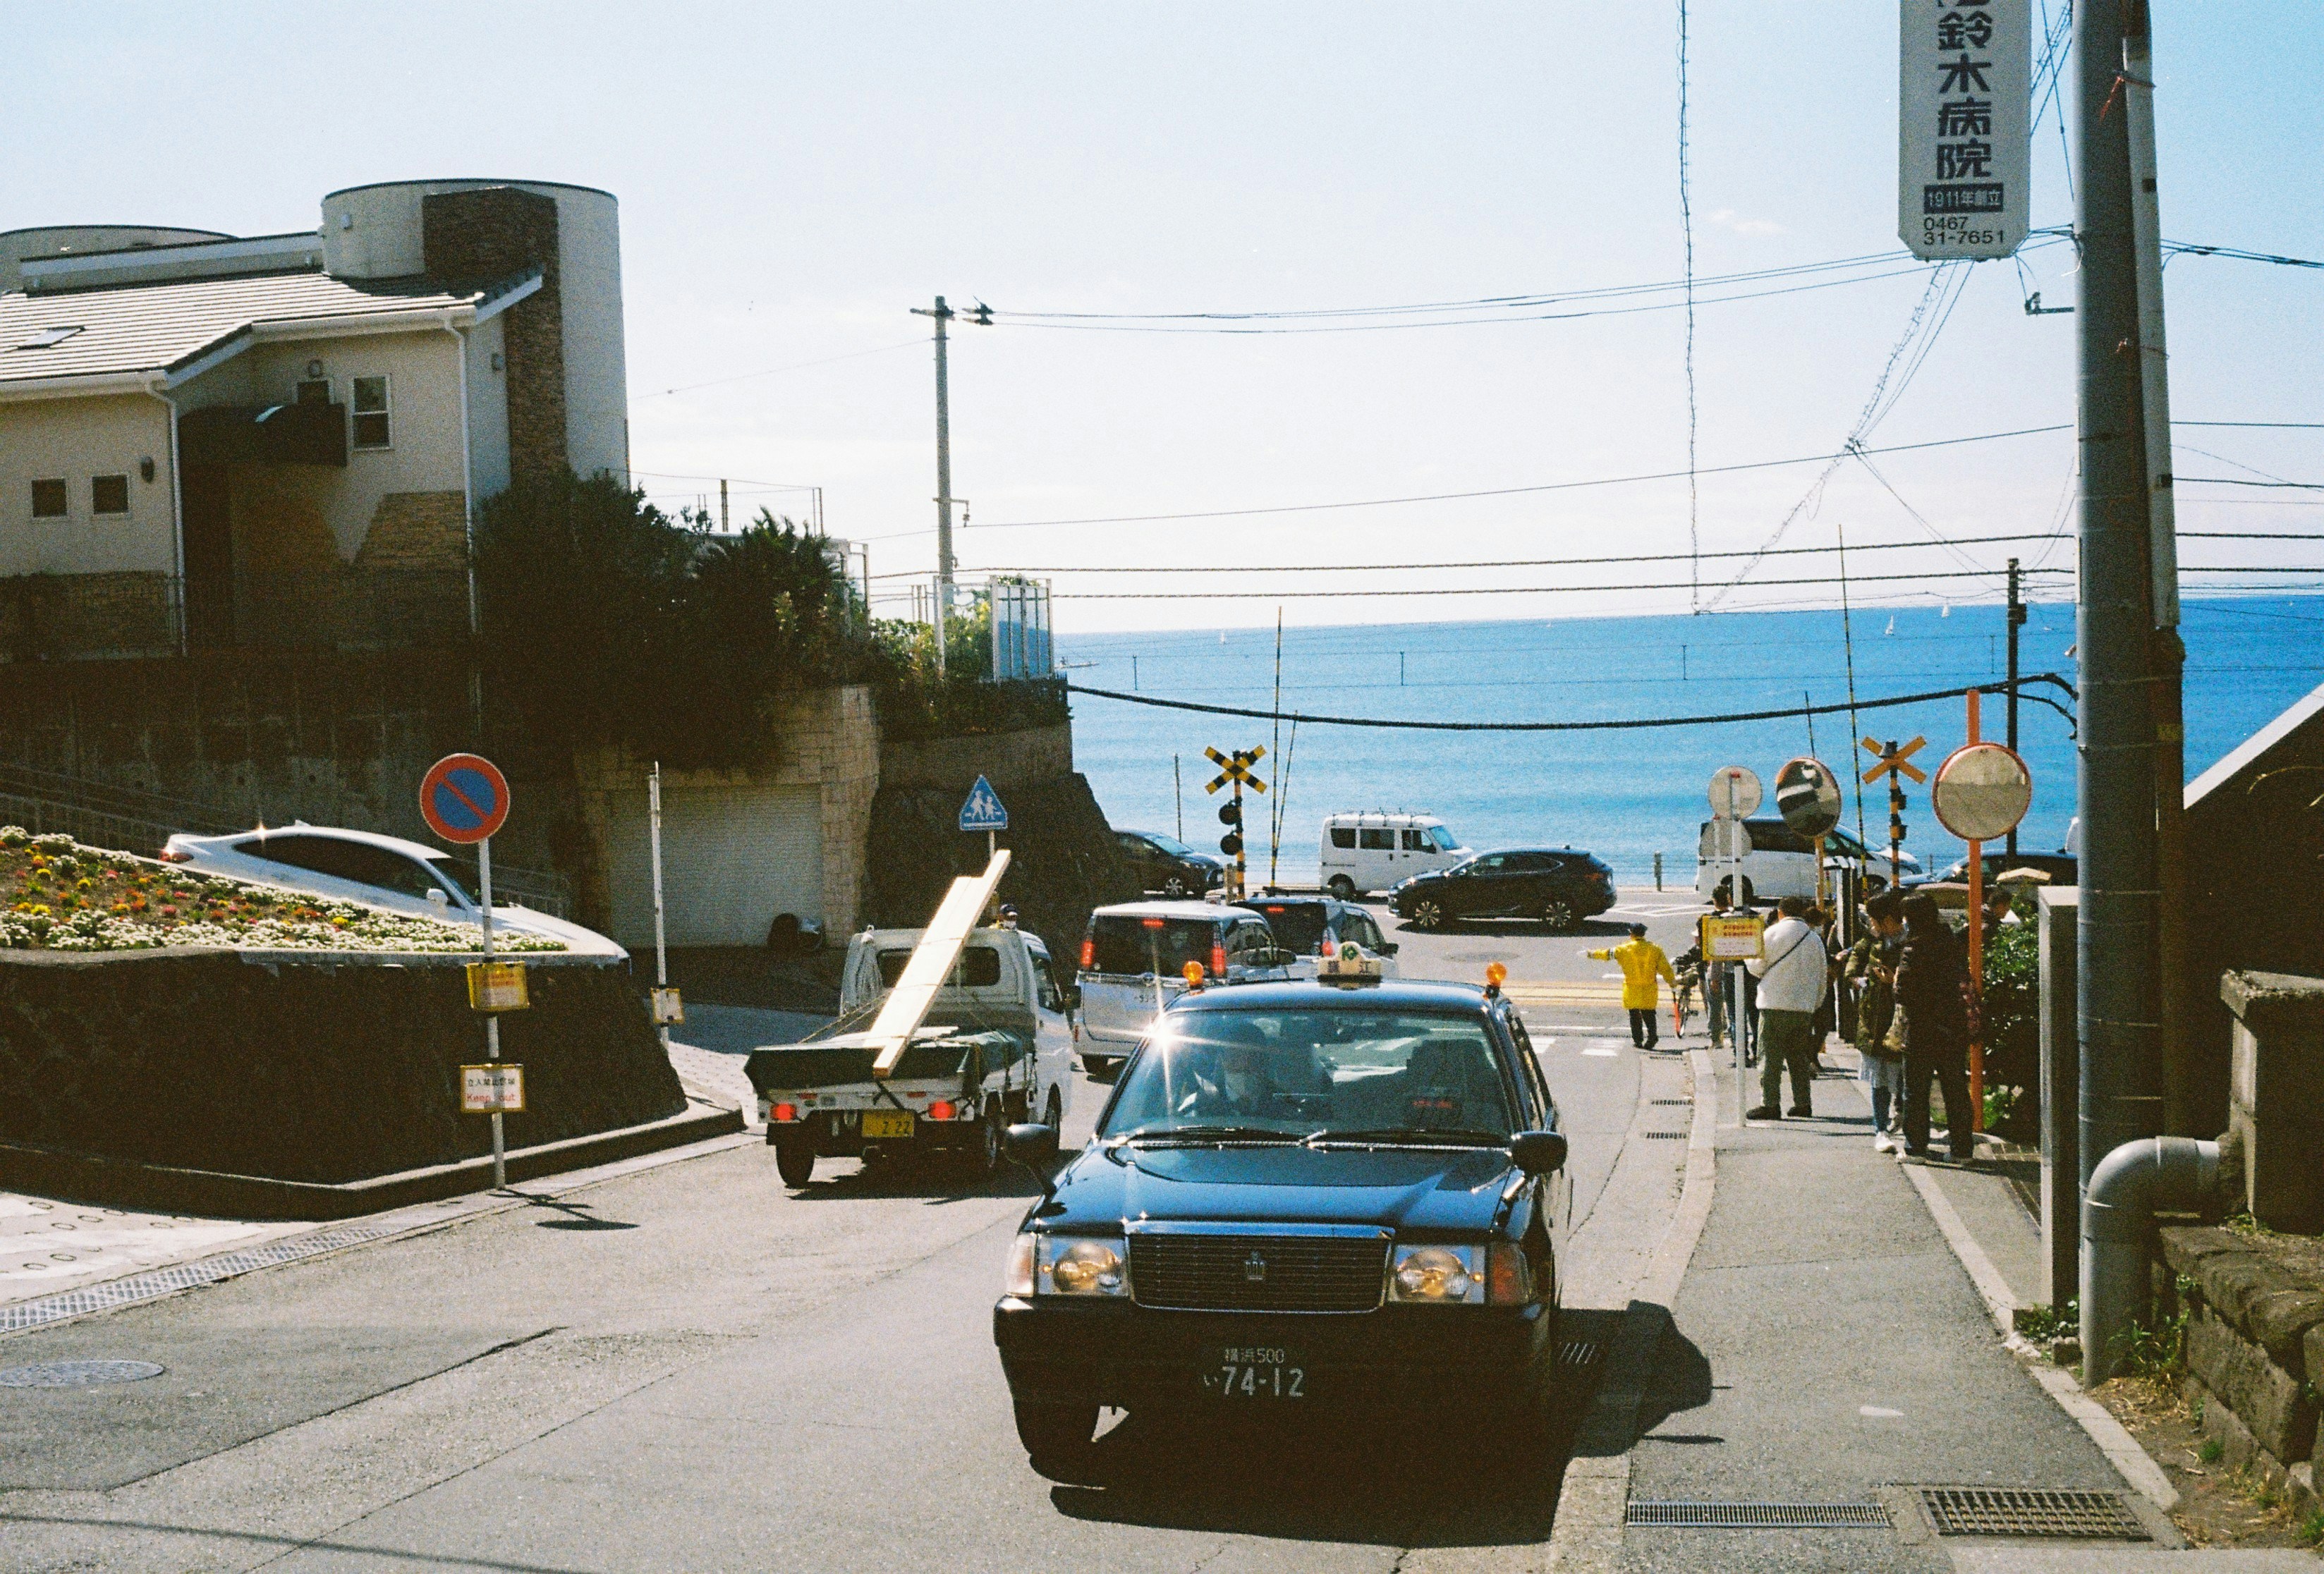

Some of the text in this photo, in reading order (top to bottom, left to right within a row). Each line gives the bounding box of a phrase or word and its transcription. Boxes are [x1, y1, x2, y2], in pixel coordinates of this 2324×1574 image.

[1937, 0, 1993, 180] 鈴木病院
[1923, 216, 1969, 231] 0467
[1923, 230, 2004, 245] 31-7651
[466, 1093, 516, 1104] Keep out
[1222, 1365, 1304, 1397] 74-12
